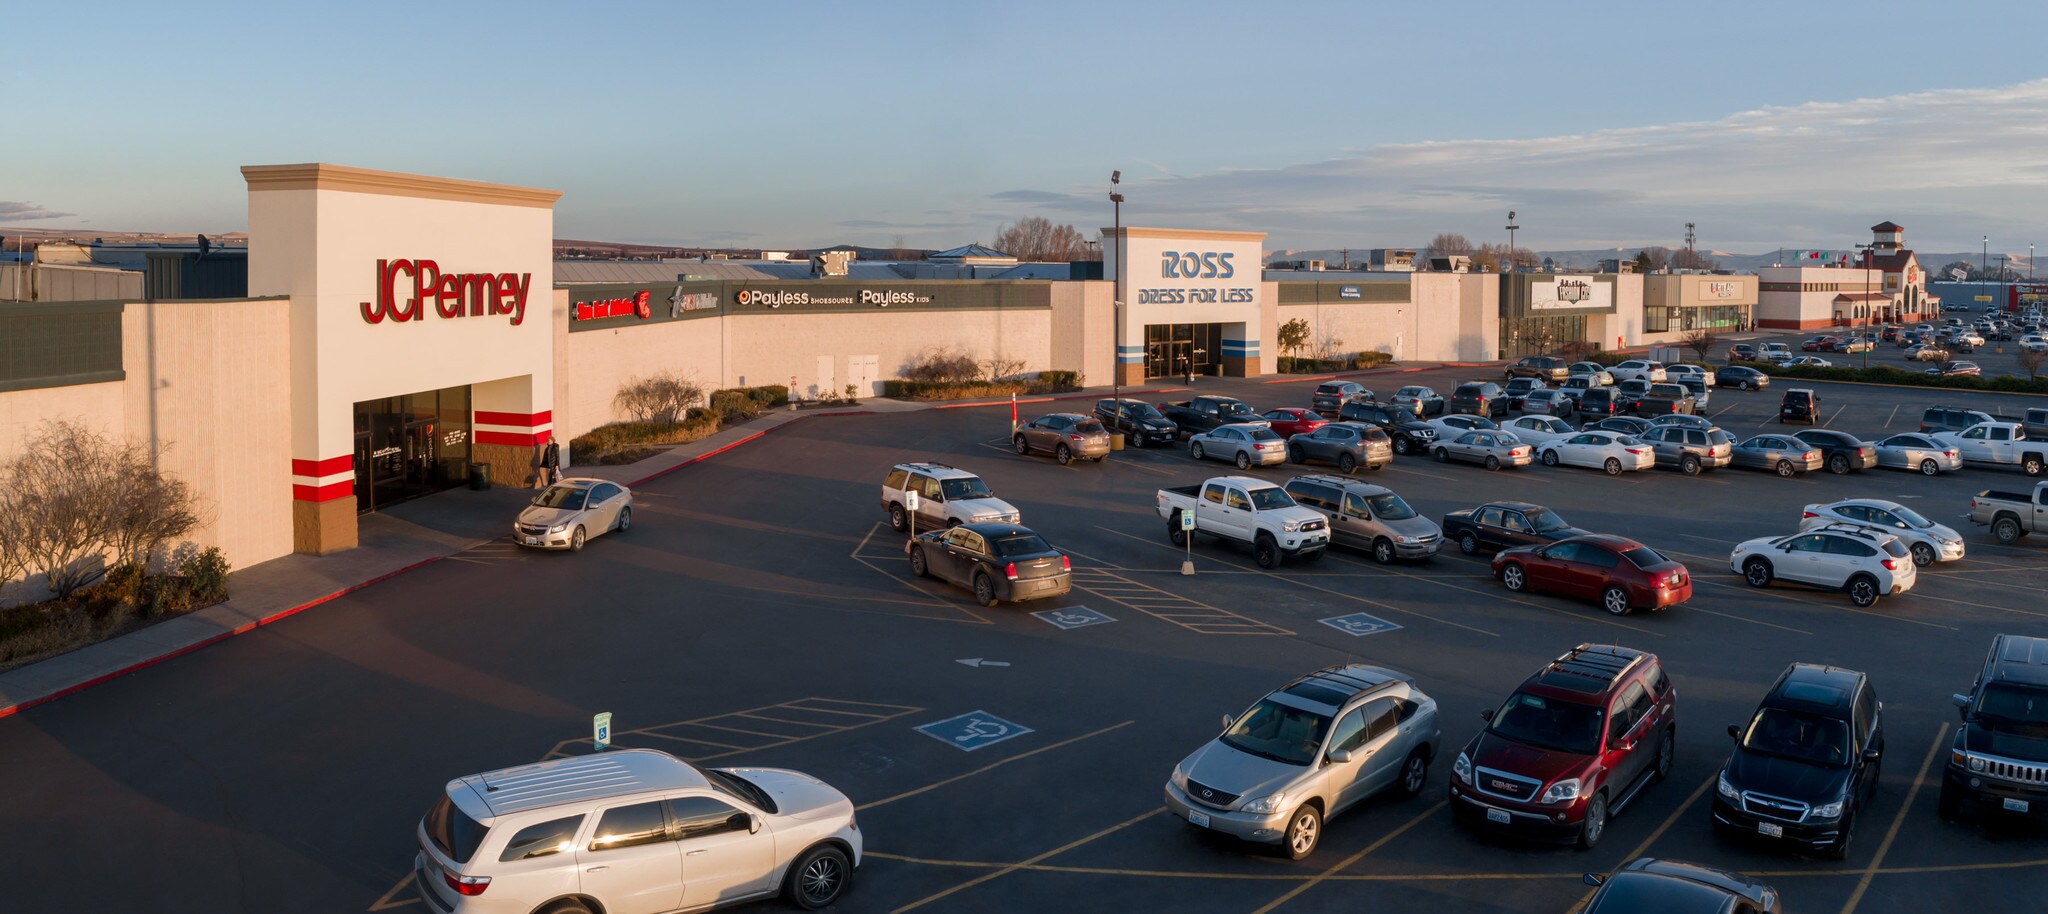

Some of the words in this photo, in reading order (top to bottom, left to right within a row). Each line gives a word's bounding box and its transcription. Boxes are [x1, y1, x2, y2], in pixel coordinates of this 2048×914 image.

[1162, 251, 1234, 279] ROSS
[360, 259, 531, 326] JCPenney
[751, 290, 808, 308] Payless
[810, 297, 853, 305] SHOESOURCE
[862, 289, 914, 307] Payless
[1138, 289, 1185, 304] DRESS
[1188, 288, 1217, 303] FOR
[1220, 288, 1253, 303] LESS
[1492, 779, 1518, 792] GMC
